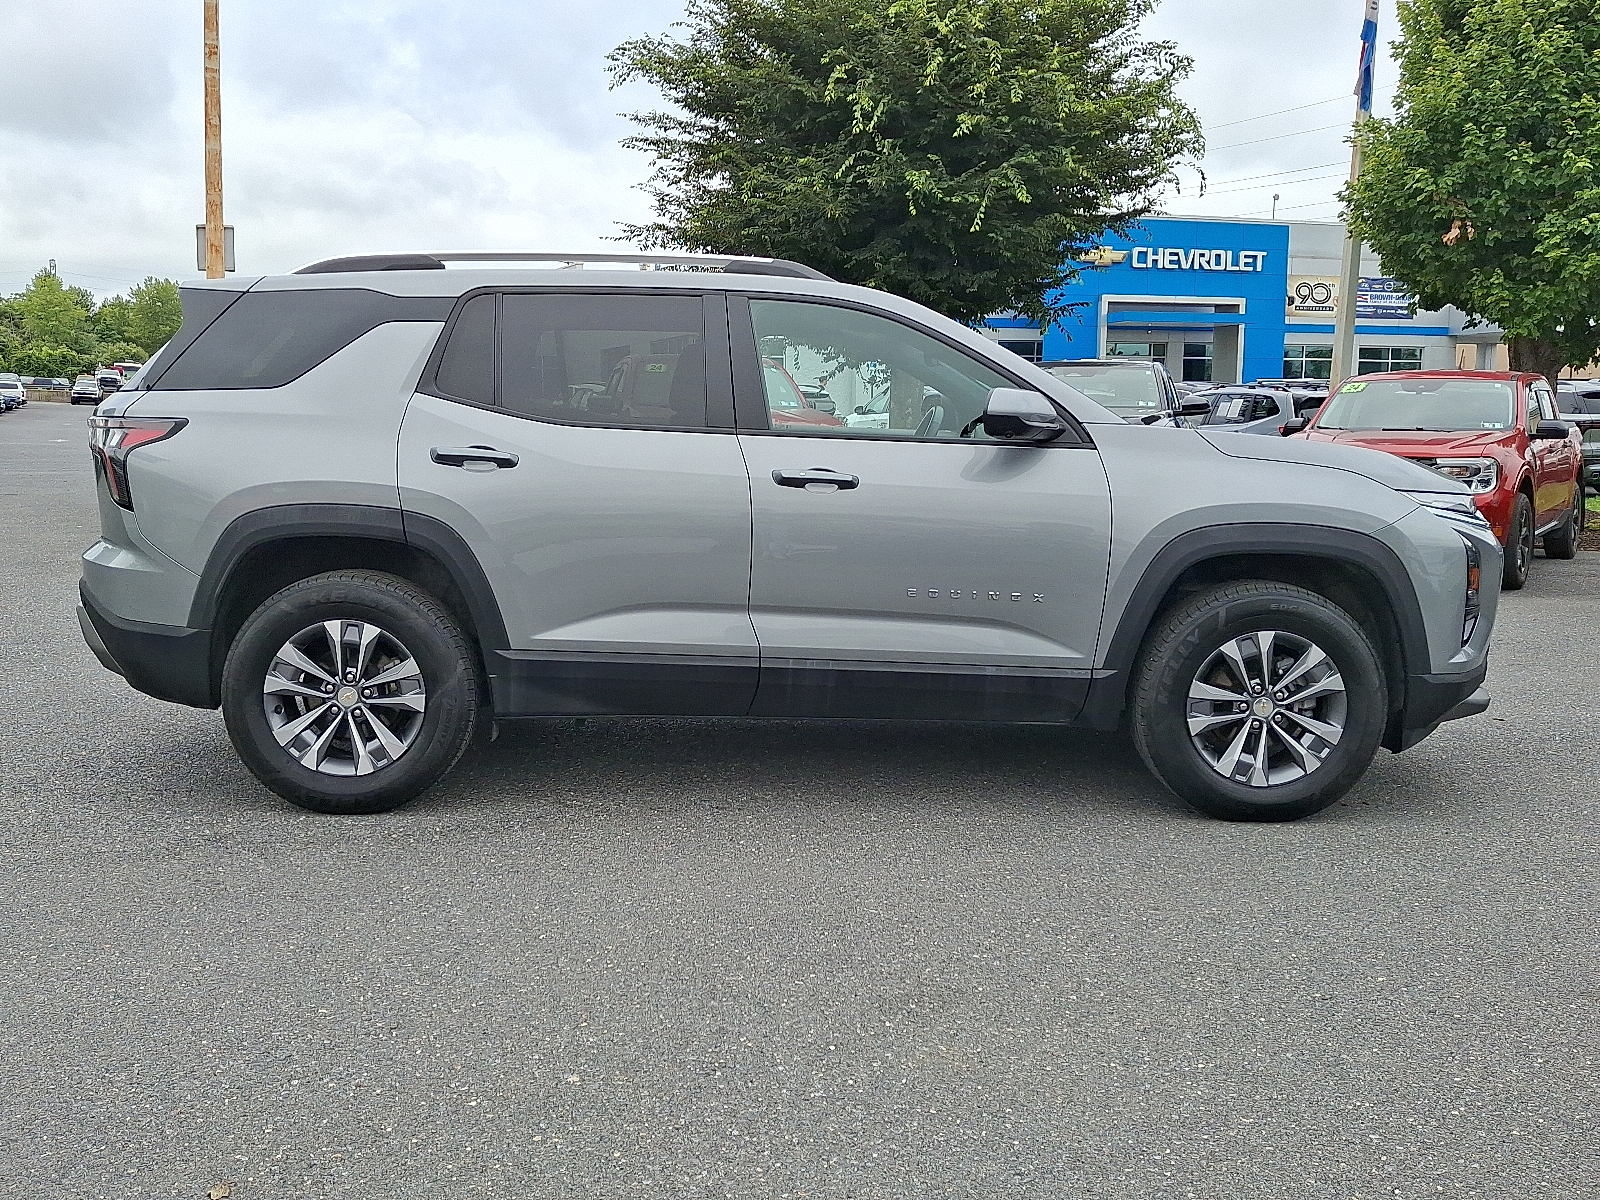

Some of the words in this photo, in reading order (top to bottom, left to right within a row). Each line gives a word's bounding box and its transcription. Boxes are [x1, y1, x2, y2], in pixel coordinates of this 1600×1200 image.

[1131, 246, 1267, 272] CHEVROLET
[1295, 282, 1336, 304] 90th
[906, 588, 1044, 603] EQUINOX
